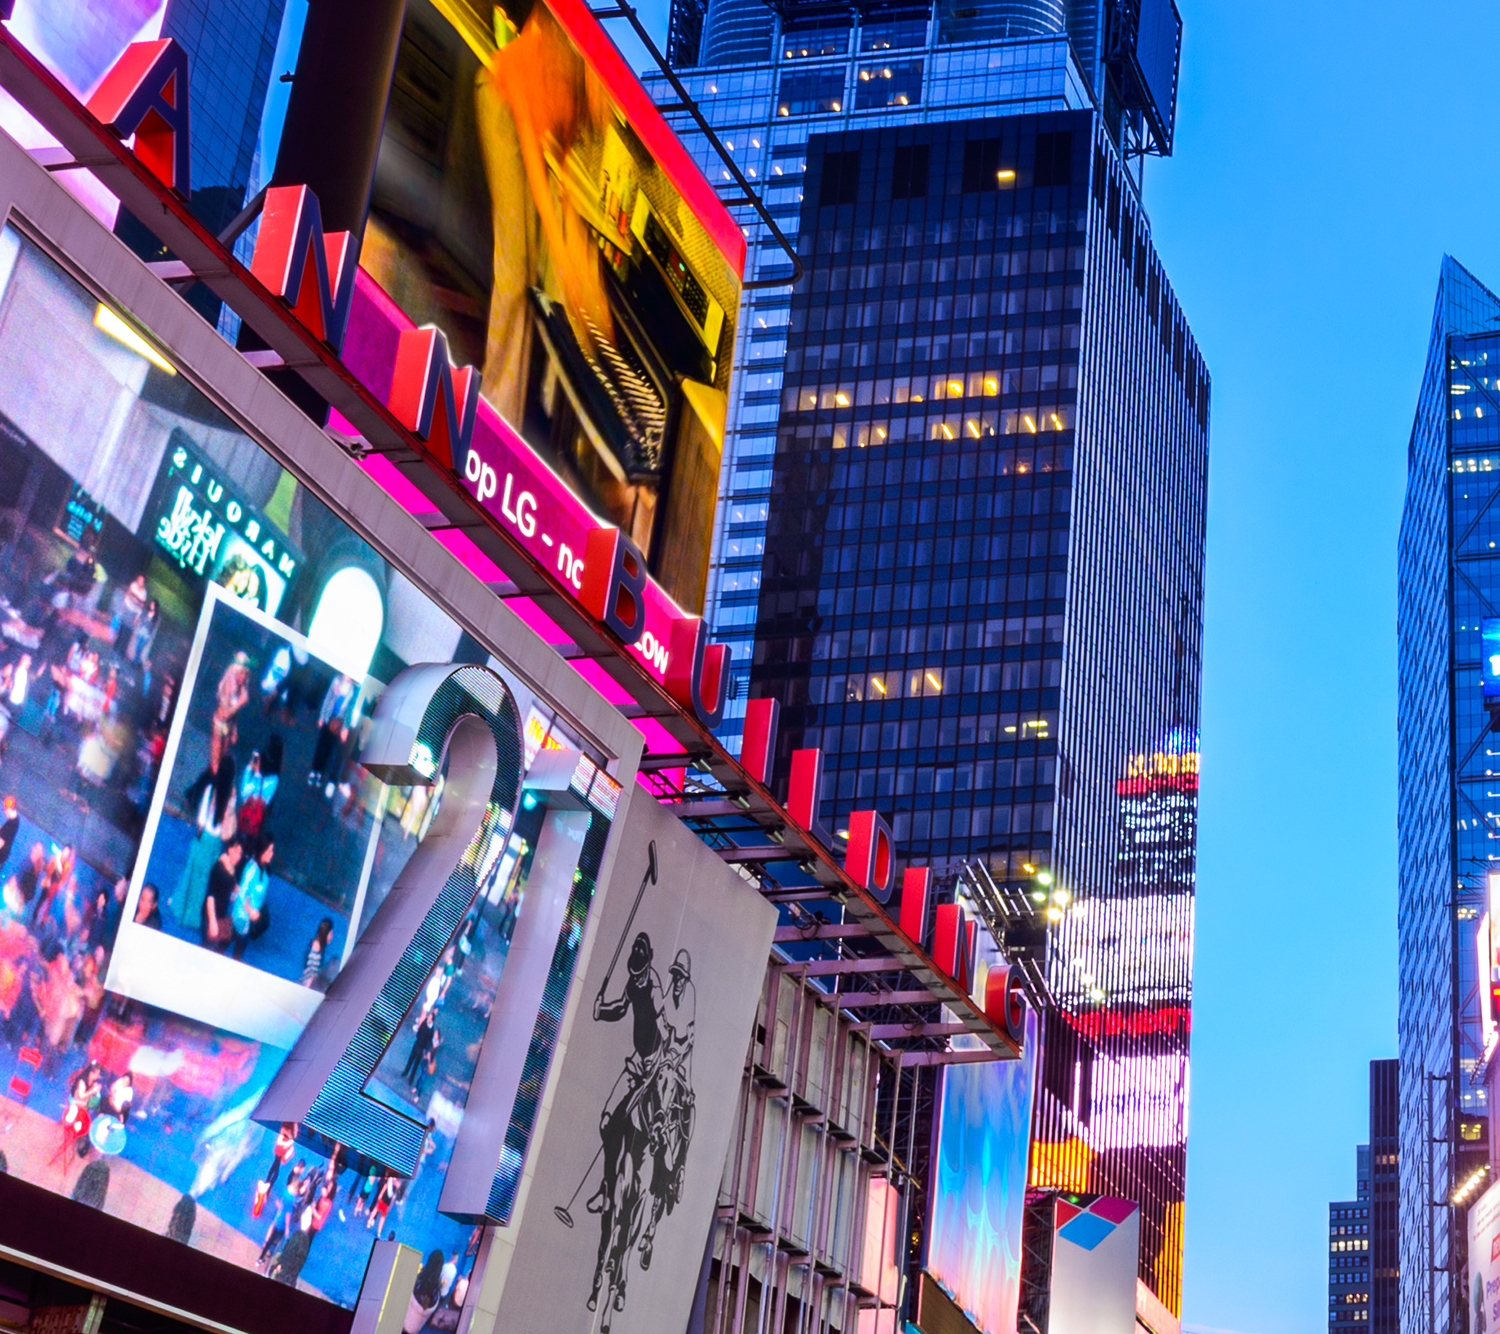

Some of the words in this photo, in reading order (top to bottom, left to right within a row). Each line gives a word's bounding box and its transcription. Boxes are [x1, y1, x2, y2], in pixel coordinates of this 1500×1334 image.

[502, 480, 536, 535] LG
[270, 664, 623, 1226] 21
[580, 527, 1025, 1042] BUILDING
